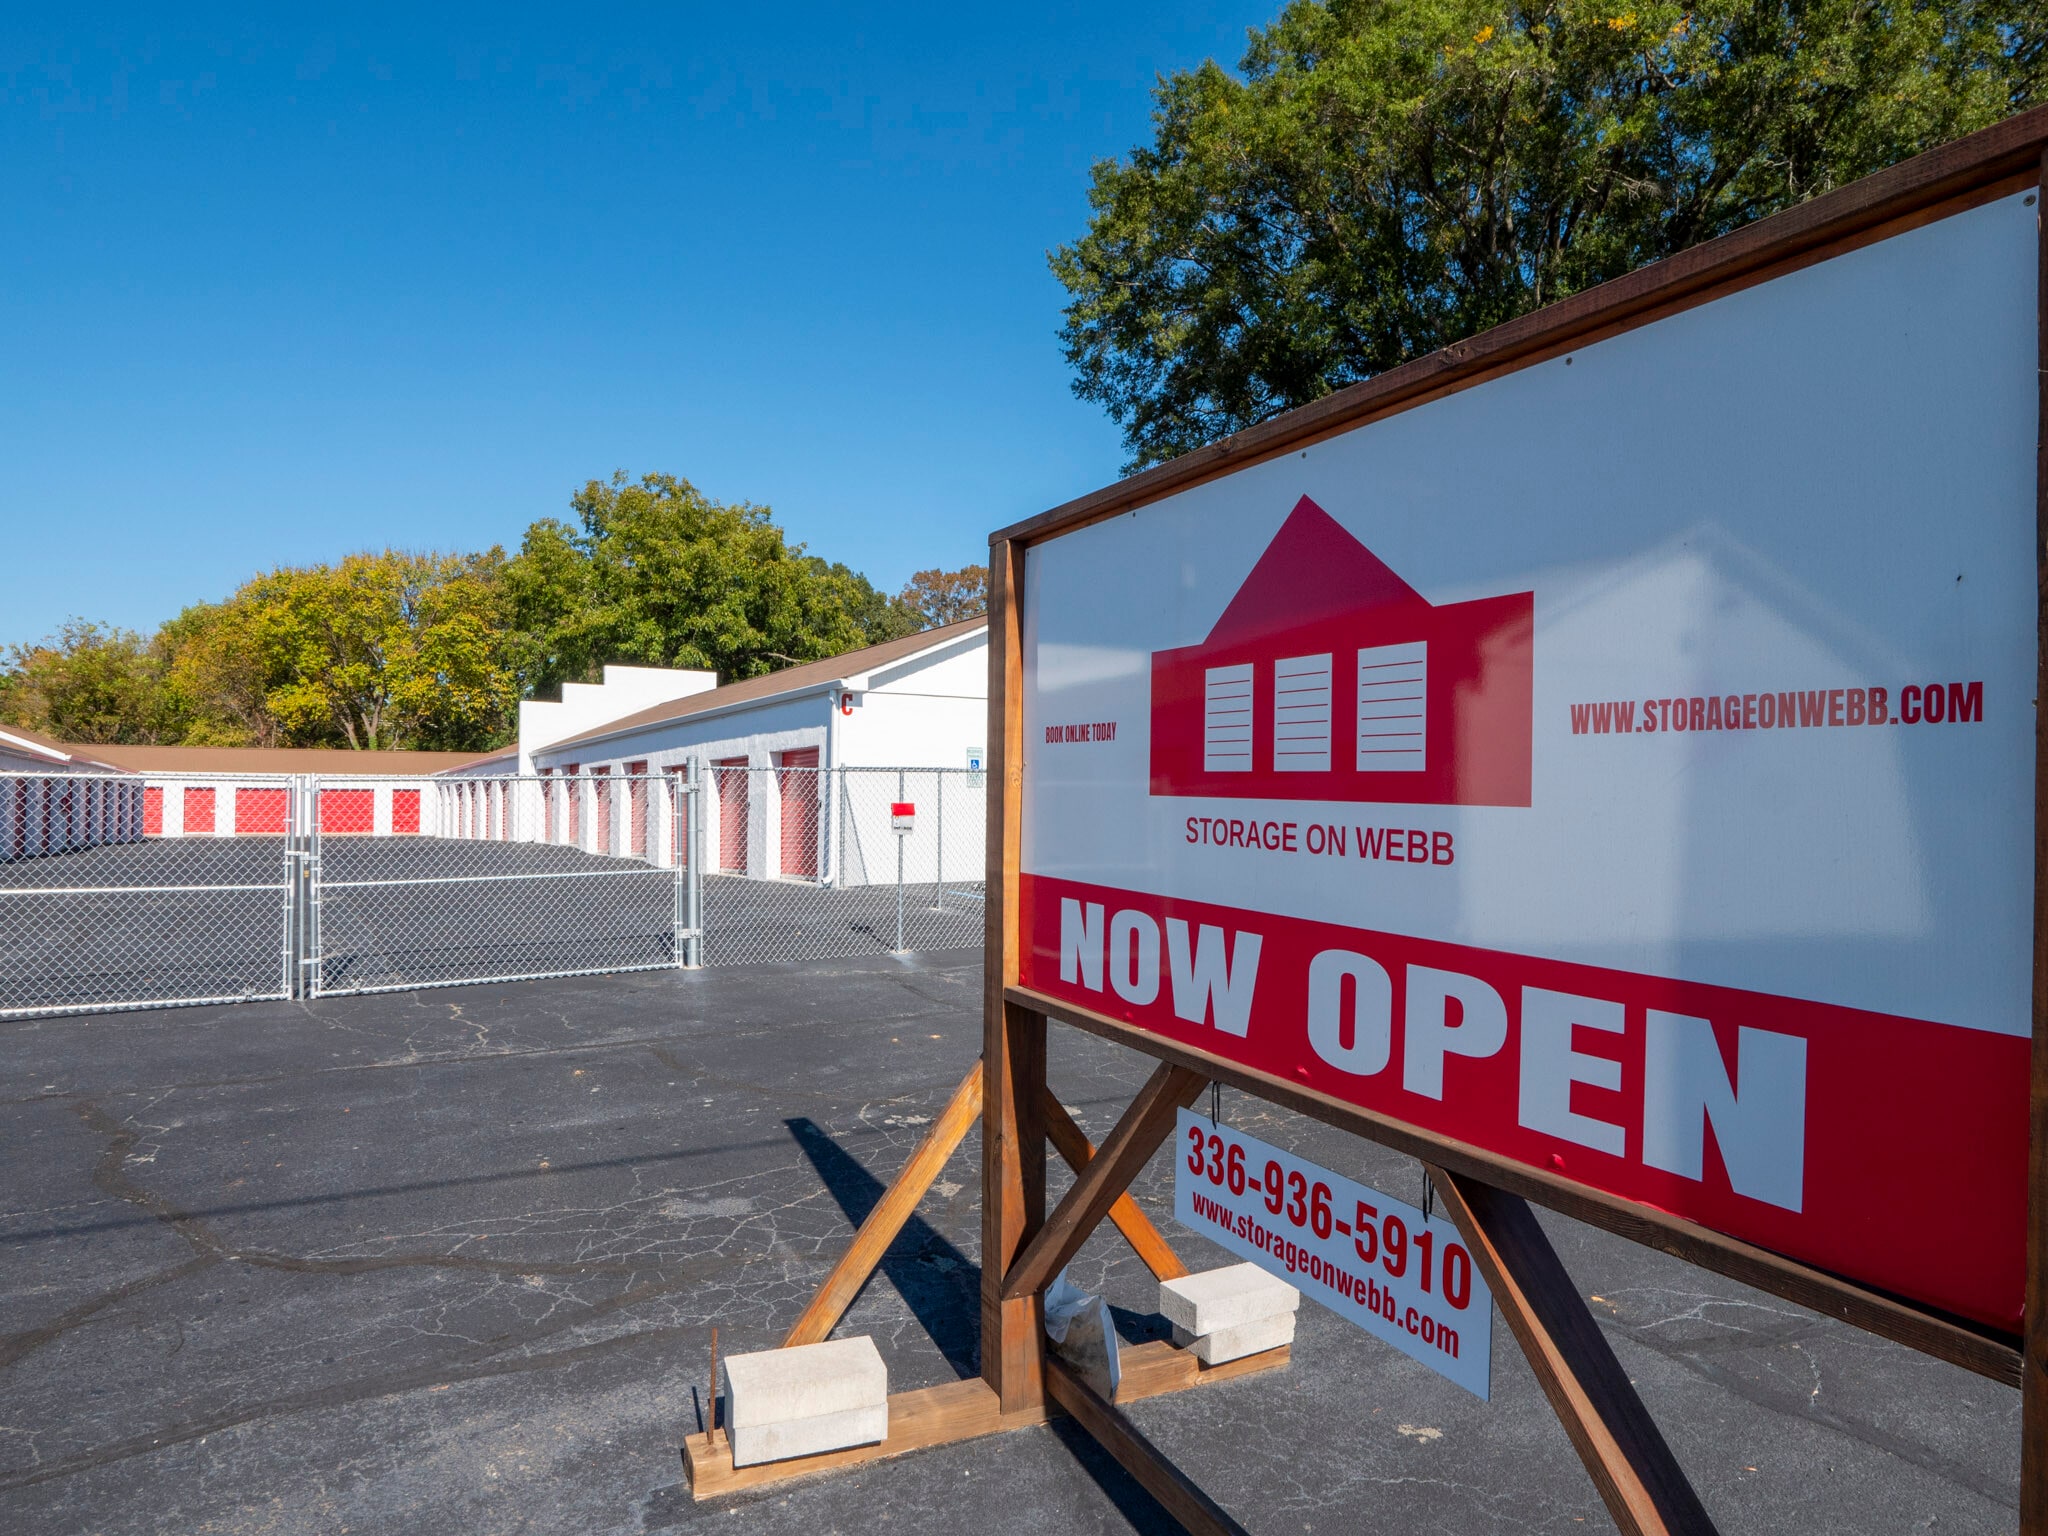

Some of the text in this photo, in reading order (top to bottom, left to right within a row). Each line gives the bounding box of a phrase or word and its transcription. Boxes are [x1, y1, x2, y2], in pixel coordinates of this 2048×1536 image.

[841, 693, 853, 716] C
[1570, 681, 1983, 735] WWW.STORAGEONWEBB.COM
[1045, 722, 1117, 743] BOOK ONLINE TODAY
[1185, 816, 1455, 866] STORAGE ON WEBB
[1060, 897, 1808, 1214] NOW OPEN
[1187, 1126, 1472, 1310] 336-936-5910
[1192, 1191, 1460, 1360] www.storageonwebb.com
